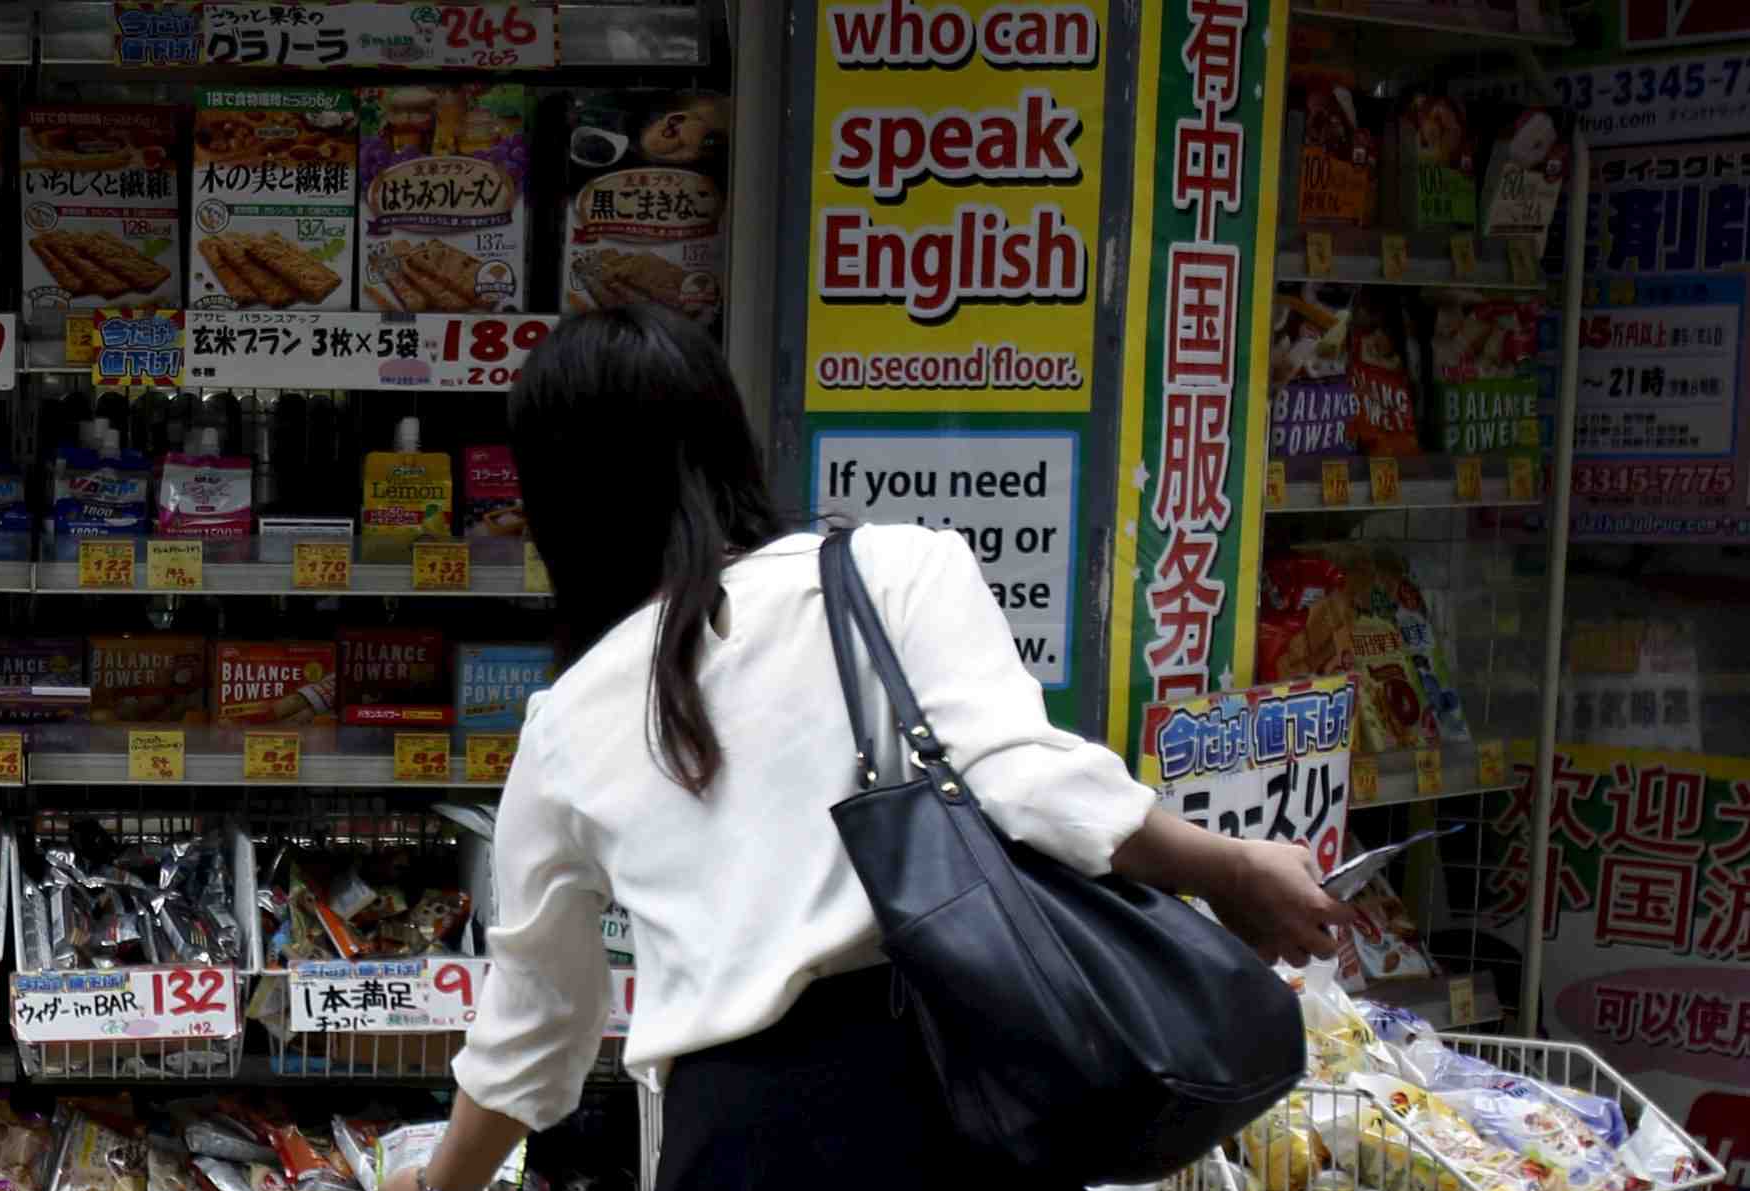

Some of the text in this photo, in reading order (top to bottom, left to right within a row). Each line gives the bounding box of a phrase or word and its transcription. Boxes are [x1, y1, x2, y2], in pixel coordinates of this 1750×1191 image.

[446, 7, 536, 47] 246
[834, 5, 1089, 56] who can
[208, 29, 347, 64] グラノーラ
[473, 50, 518, 66] 265
[840, 97, 1068, 185] speak
[381, 175, 500, 211] はちみつレーズン
[591, 190, 711, 220] 黒ごまきなこ
[825, 212, 1075, 309] English
[819, 348, 1080, 384] on second floor.
[1150, 0, 1246, 698] 有中国服务
[371, 482, 443, 498] Lemon
[830, 461, 1046, 506] If you need
[1017, 527, 1056, 553] or
[222, 662, 302, 682] BALANCE
[463, 664, 543, 683] BALANCE
[221, 682, 285, 703] POWER
[463, 684, 526, 703] POWER
[153, 969, 228, 1016] 132
[302, 982, 418, 1017] 1本満足
